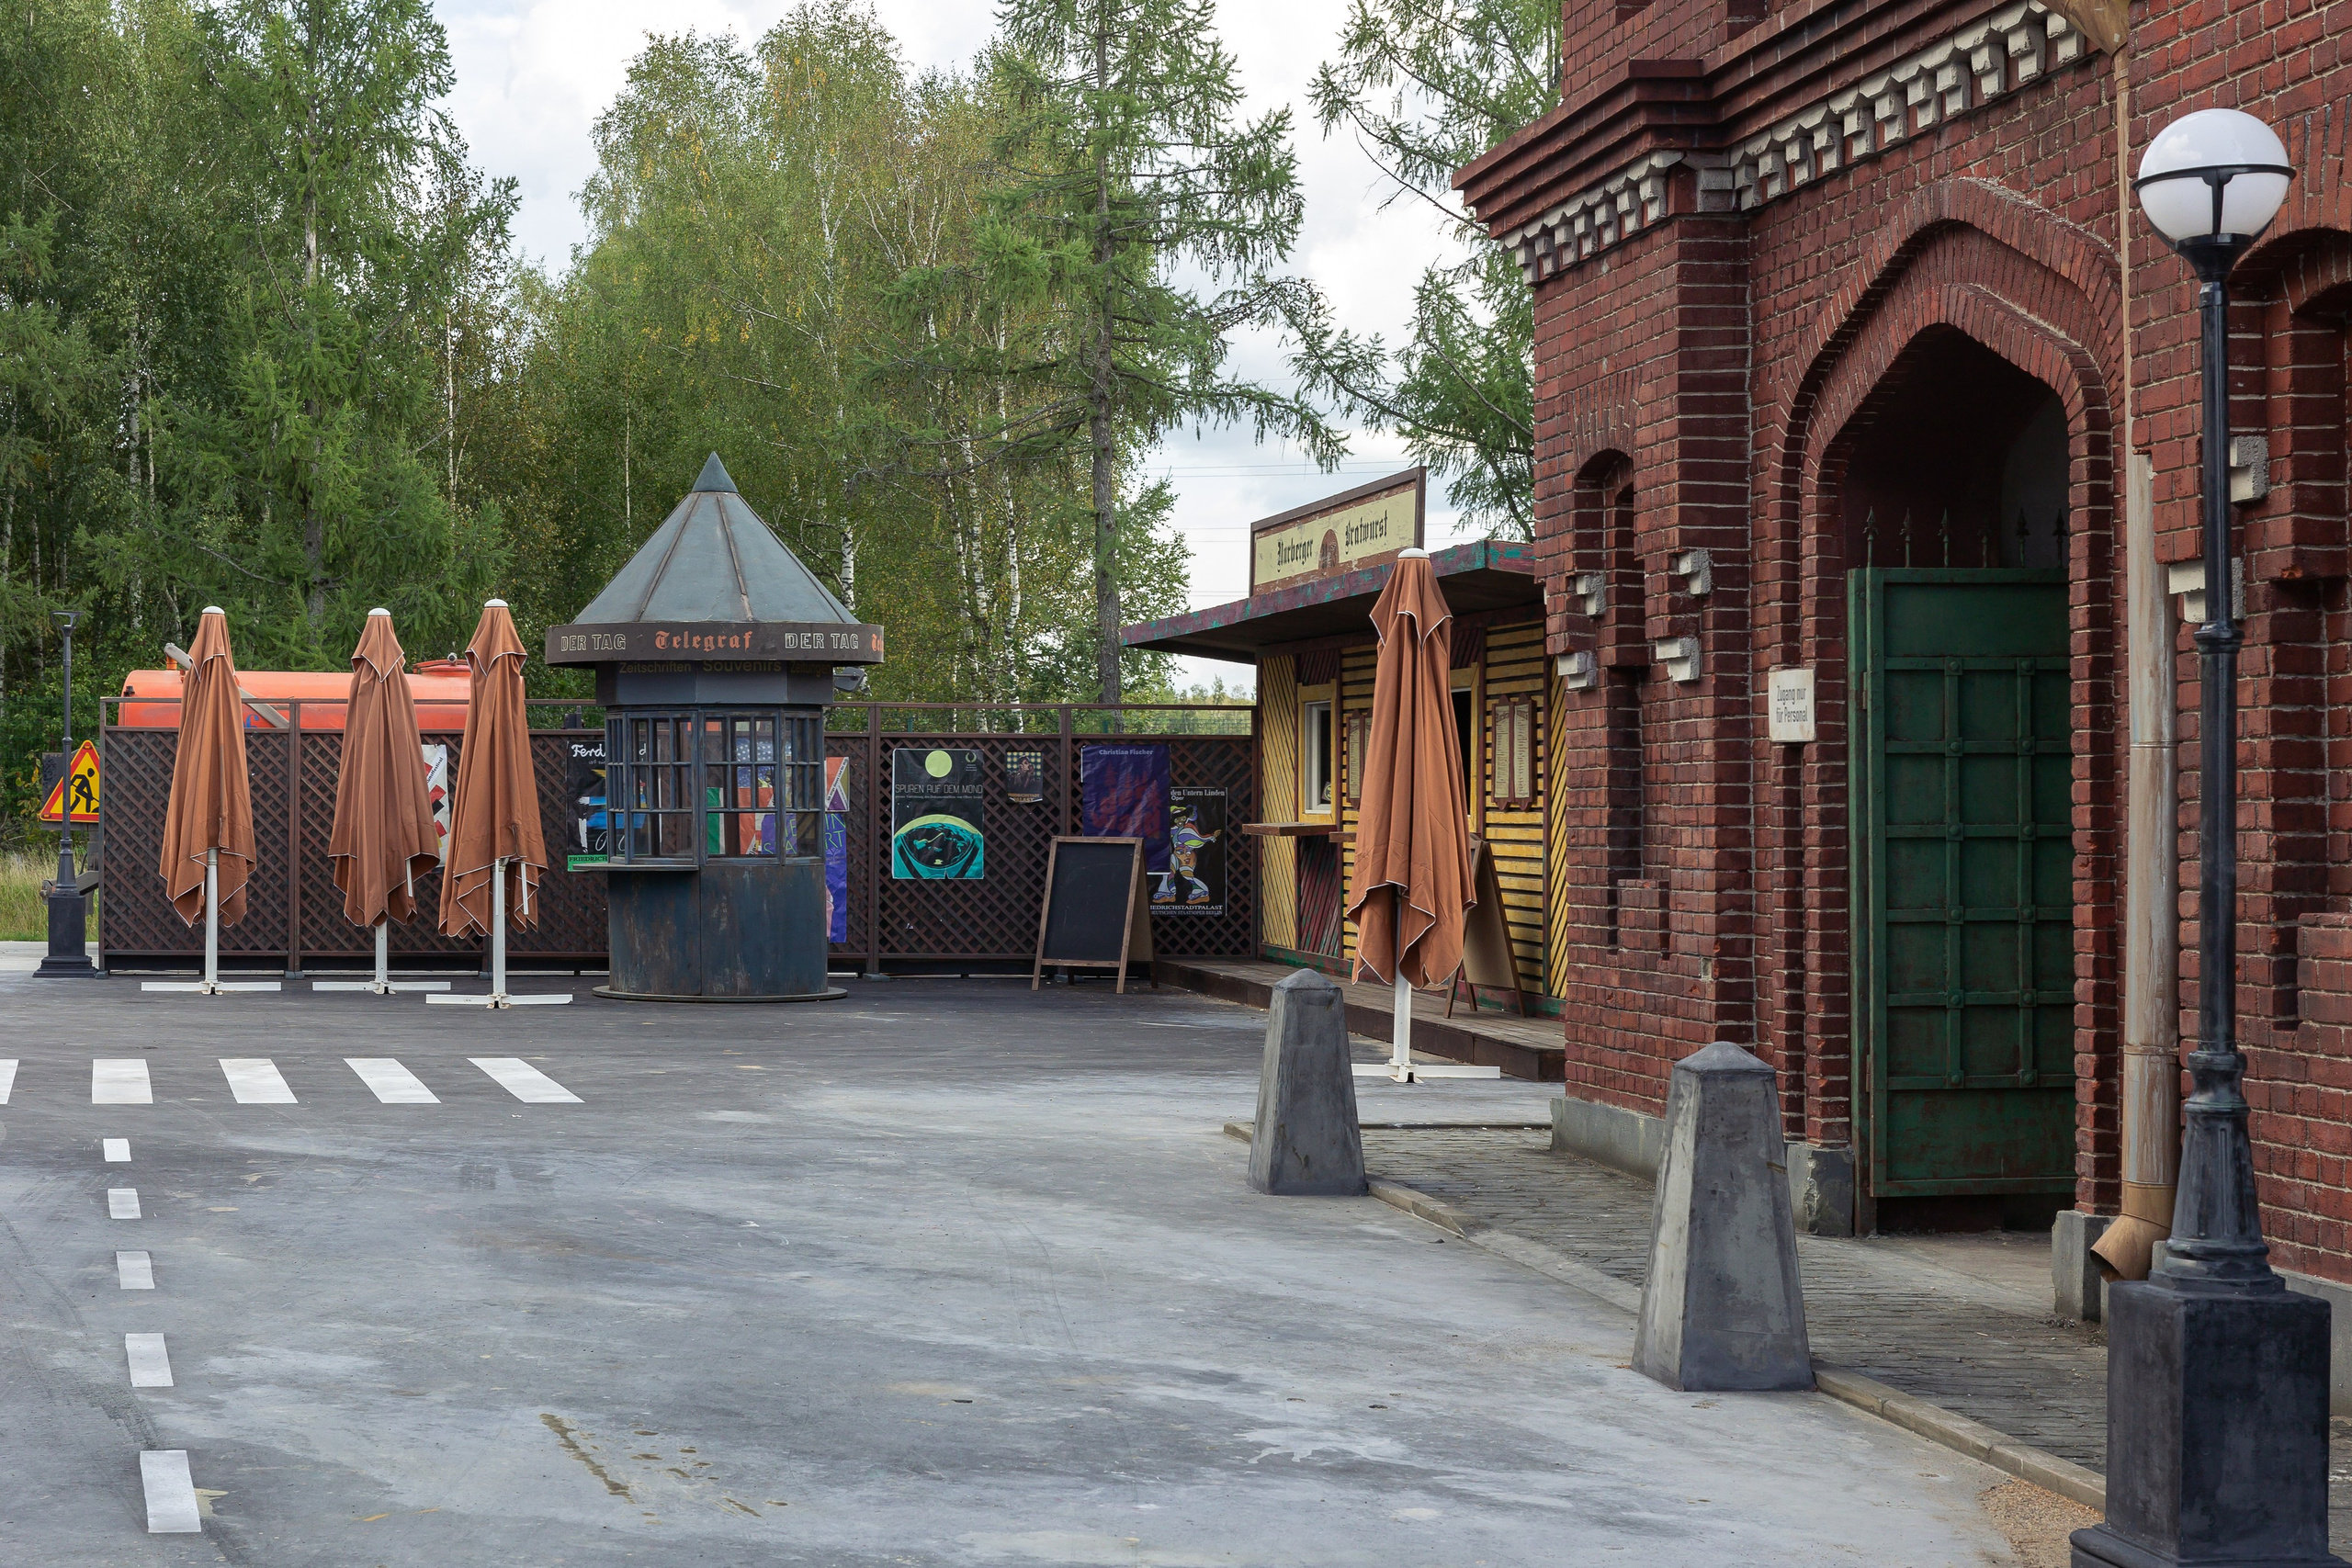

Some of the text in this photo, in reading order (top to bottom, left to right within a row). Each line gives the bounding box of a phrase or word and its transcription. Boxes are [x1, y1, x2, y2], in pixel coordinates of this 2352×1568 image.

[1345, 509, 1388, 555] Bratwurst
[560, 635, 587, 652] DER
[592, 633, 627, 650] TAG
[655, 629, 753, 653] Telegraf
[785, 633, 825, 649] DER
[831, 633, 859, 649] TAG
[619, 660, 832, 678] Zeitschriften Souvenirs Zeitungen
[1777, 685, 1806, 705] Zugang nur
[1784, 705, 1808, 722] Personal
[895, 784, 983, 794] SPUREN AUF DEM MOND
